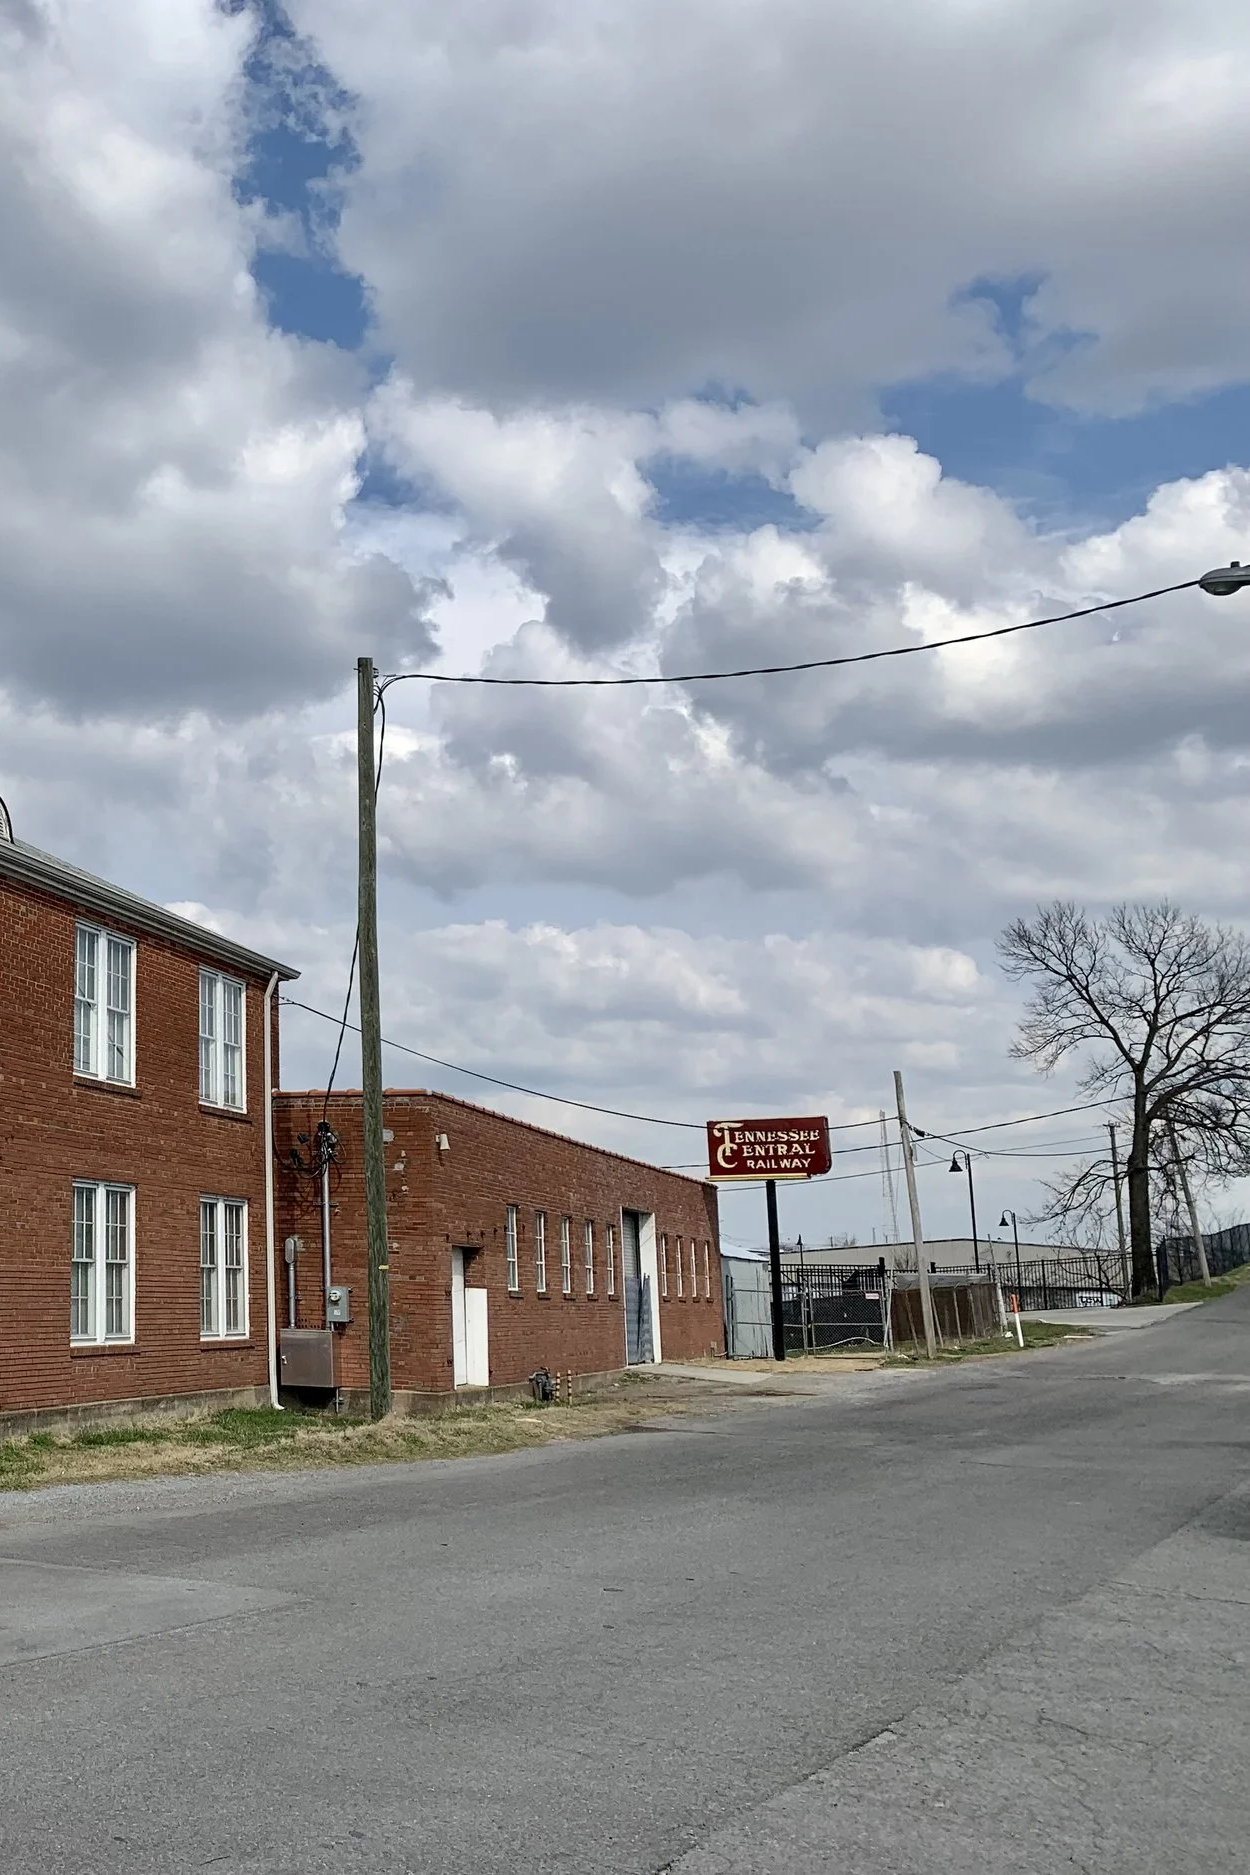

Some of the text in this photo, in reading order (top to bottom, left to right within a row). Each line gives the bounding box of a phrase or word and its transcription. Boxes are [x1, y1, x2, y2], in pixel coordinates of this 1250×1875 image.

[713, 1122, 820, 1155] TENNESSEE
[717, 1142, 816, 1168] CENTRAL
[747, 1158, 811, 1169] RAILWAY
